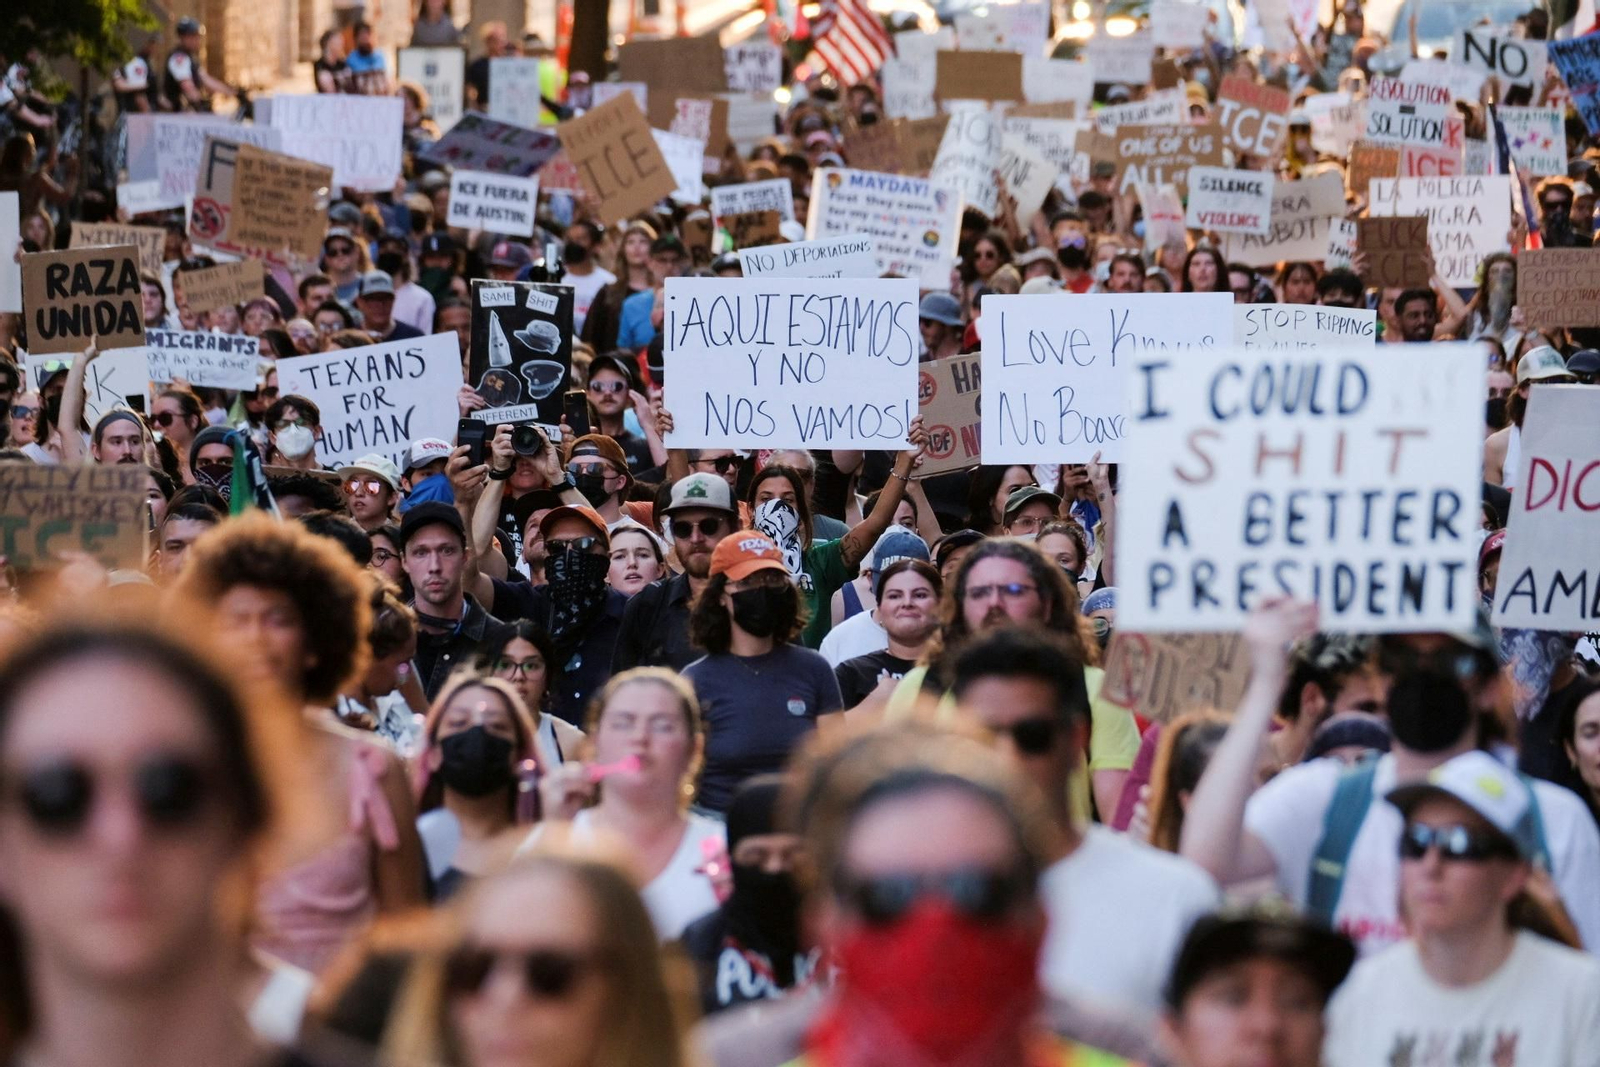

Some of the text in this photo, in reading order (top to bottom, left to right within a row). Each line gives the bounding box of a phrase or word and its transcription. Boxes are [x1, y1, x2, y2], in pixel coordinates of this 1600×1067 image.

[1463, 32, 1528, 78] NO
[1370, 77, 1451, 105] REVOLUTION
[1188, 134, 1214, 155] US
[1366, 111, 1444, 142] SOLUTION
[580, 128, 661, 201] ICE
[1406, 150, 1456, 177] ICE
[457, 181, 529, 203] ICE FUERA
[849, 173, 929, 197] MAYDAY!
[1199, 176, 1264, 196] SILENCE
[1415, 177, 1485, 198] POLICIA
[453, 202, 468, 218] DE
[1197, 212, 1260, 229] VIOLENCE
[745, 254, 775, 276] NO
[783, 240, 872, 268] DEPORTATIONS
[46, 258, 141, 300] RAZA
[482, 290, 555, 312] SAME SHIT
[36, 300, 141, 340] UNIDA
[670, 293, 913, 367] ¡AQUI ESTAMOS
[1246, 307, 1375, 337] STOP RIPPING
[145, 331, 256, 356] MIGRANTS
[1001, 310, 1097, 368] Love
[300, 347, 426, 391] TEXANS
[747, 349, 826, 386] Y NO
[342, 385, 396, 415] FOR
[1138, 361, 1370, 422] I COULD
[313, 404, 416, 456] HUMAN
[474, 407, 535, 424] DIFFERENT
[704, 391, 776, 437] NOS
[791, 399, 912, 443] VAMOS!
[999, 391, 1047, 446] No
[1172, 428, 1430, 485] SHIT
[1161, 489, 1463, 549] A BETTER
[1148, 557, 1467, 617] PRESIDENT
